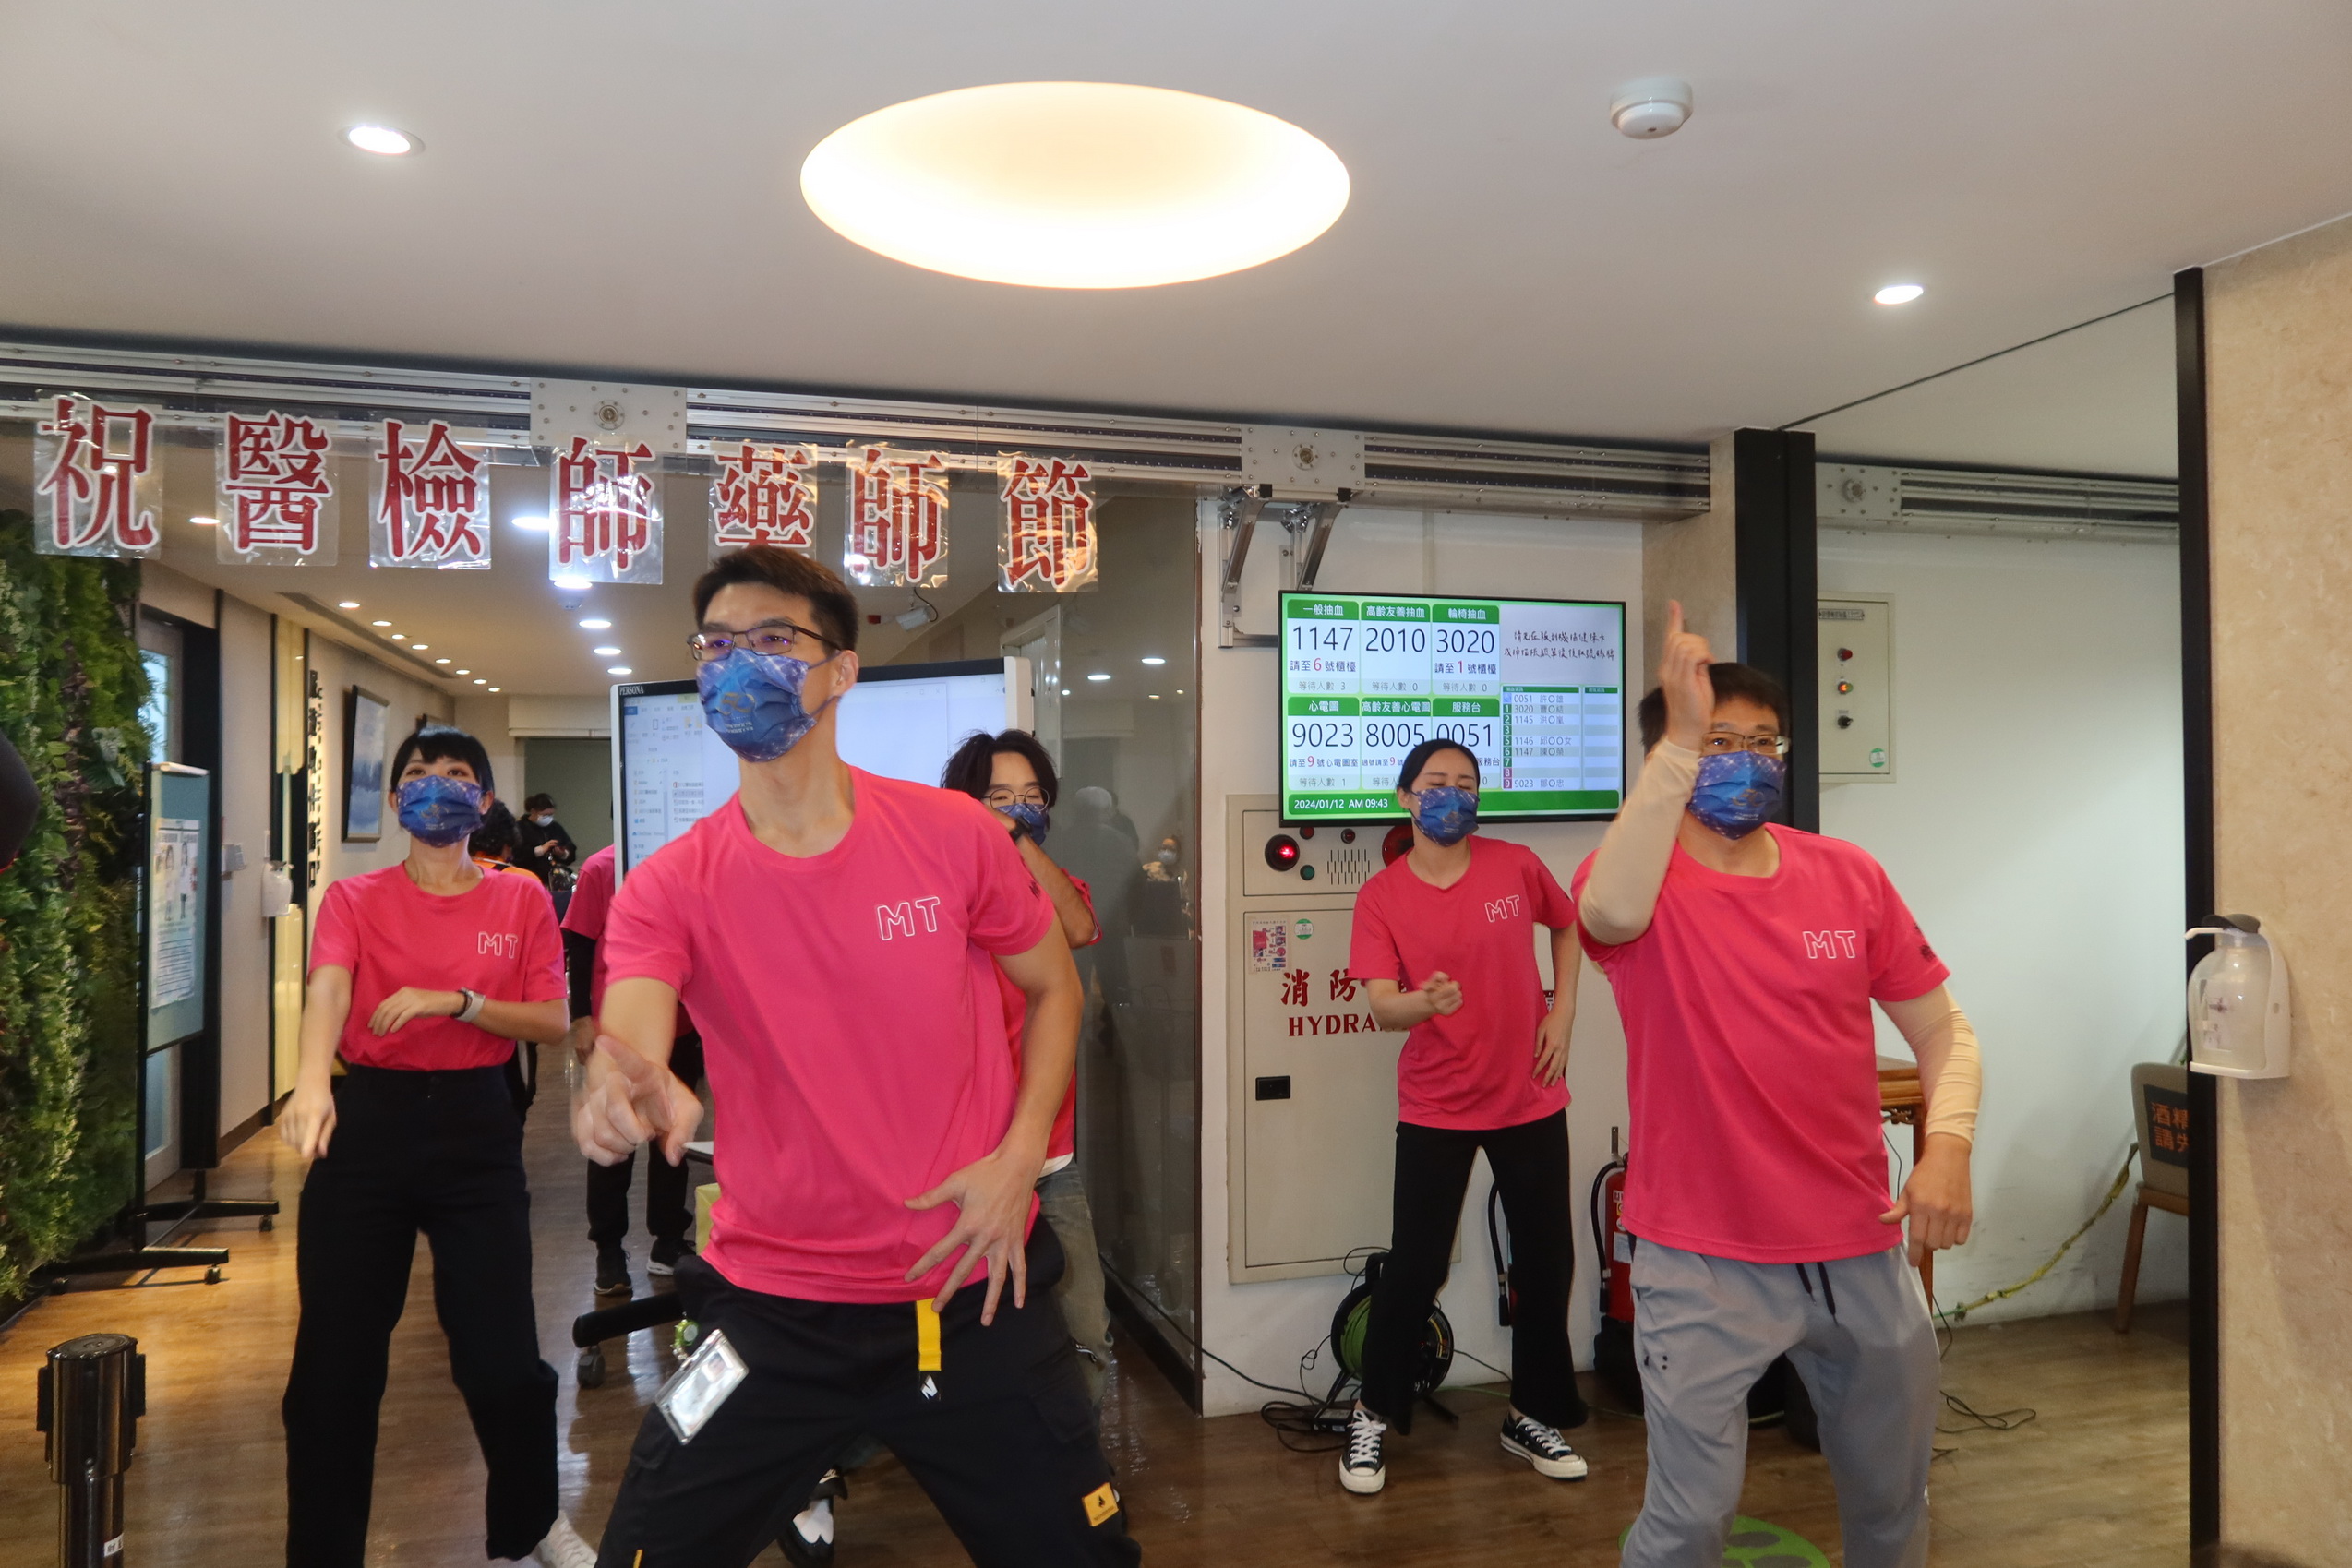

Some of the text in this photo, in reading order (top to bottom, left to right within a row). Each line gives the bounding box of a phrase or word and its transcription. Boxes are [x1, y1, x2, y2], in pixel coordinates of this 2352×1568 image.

[1303, 604, 1343, 616] 一般抽血
[1447, 608, 1486, 620] 輪椅抽血
[1292, 626, 1353, 650] 1147
[1365, 628, 1425, 652] 2010
[1436, 629, 1494, 653] 3020
[619, 686, 644, 695] PERSONA
[1299, 681, 1346, 691] 等待人數 3
[1372, 682, 1418, 691] 等待人數 0
[1443, 683, 1488, 692] 等待人數 0
[1514, 694, 1532, 703] 0051
[1308, 700, 1338, 712] 心電圖
[1452, 701, 1481, 712] 服務台
[1514, 705, 1534, 713] 3020
[1505, 715, 1510, 724] 2
[1515, 715, 1533, 724] 1145
[1292, 723, 1353, 747] 9023
[1365, 723, 1425, 747] 8005
[1436, 724, 1492, 747] 0051
[1505, 748, 1510, 756] 6
[1515, 748, 1533, 756] 1147
[1505, 769, 1510, 777] 8
[1299, 777, 1335, 787] 等待人數
[1482, 776, 1488, 784] 0
[1505, 779, 1510, 787] 9
[1514, 779, 1534, 788] 9023
[1294, 798, 1388, 809] 2024/01/12 AM 09:43
[1484, 894, 1520, 923] MT
[877, 896, 941, 941] MT
[477, 931, 519, 959] MT
[1802, 930, 1856, 959] MT
[1289, 1013, 1408, 1036] HYDRA
